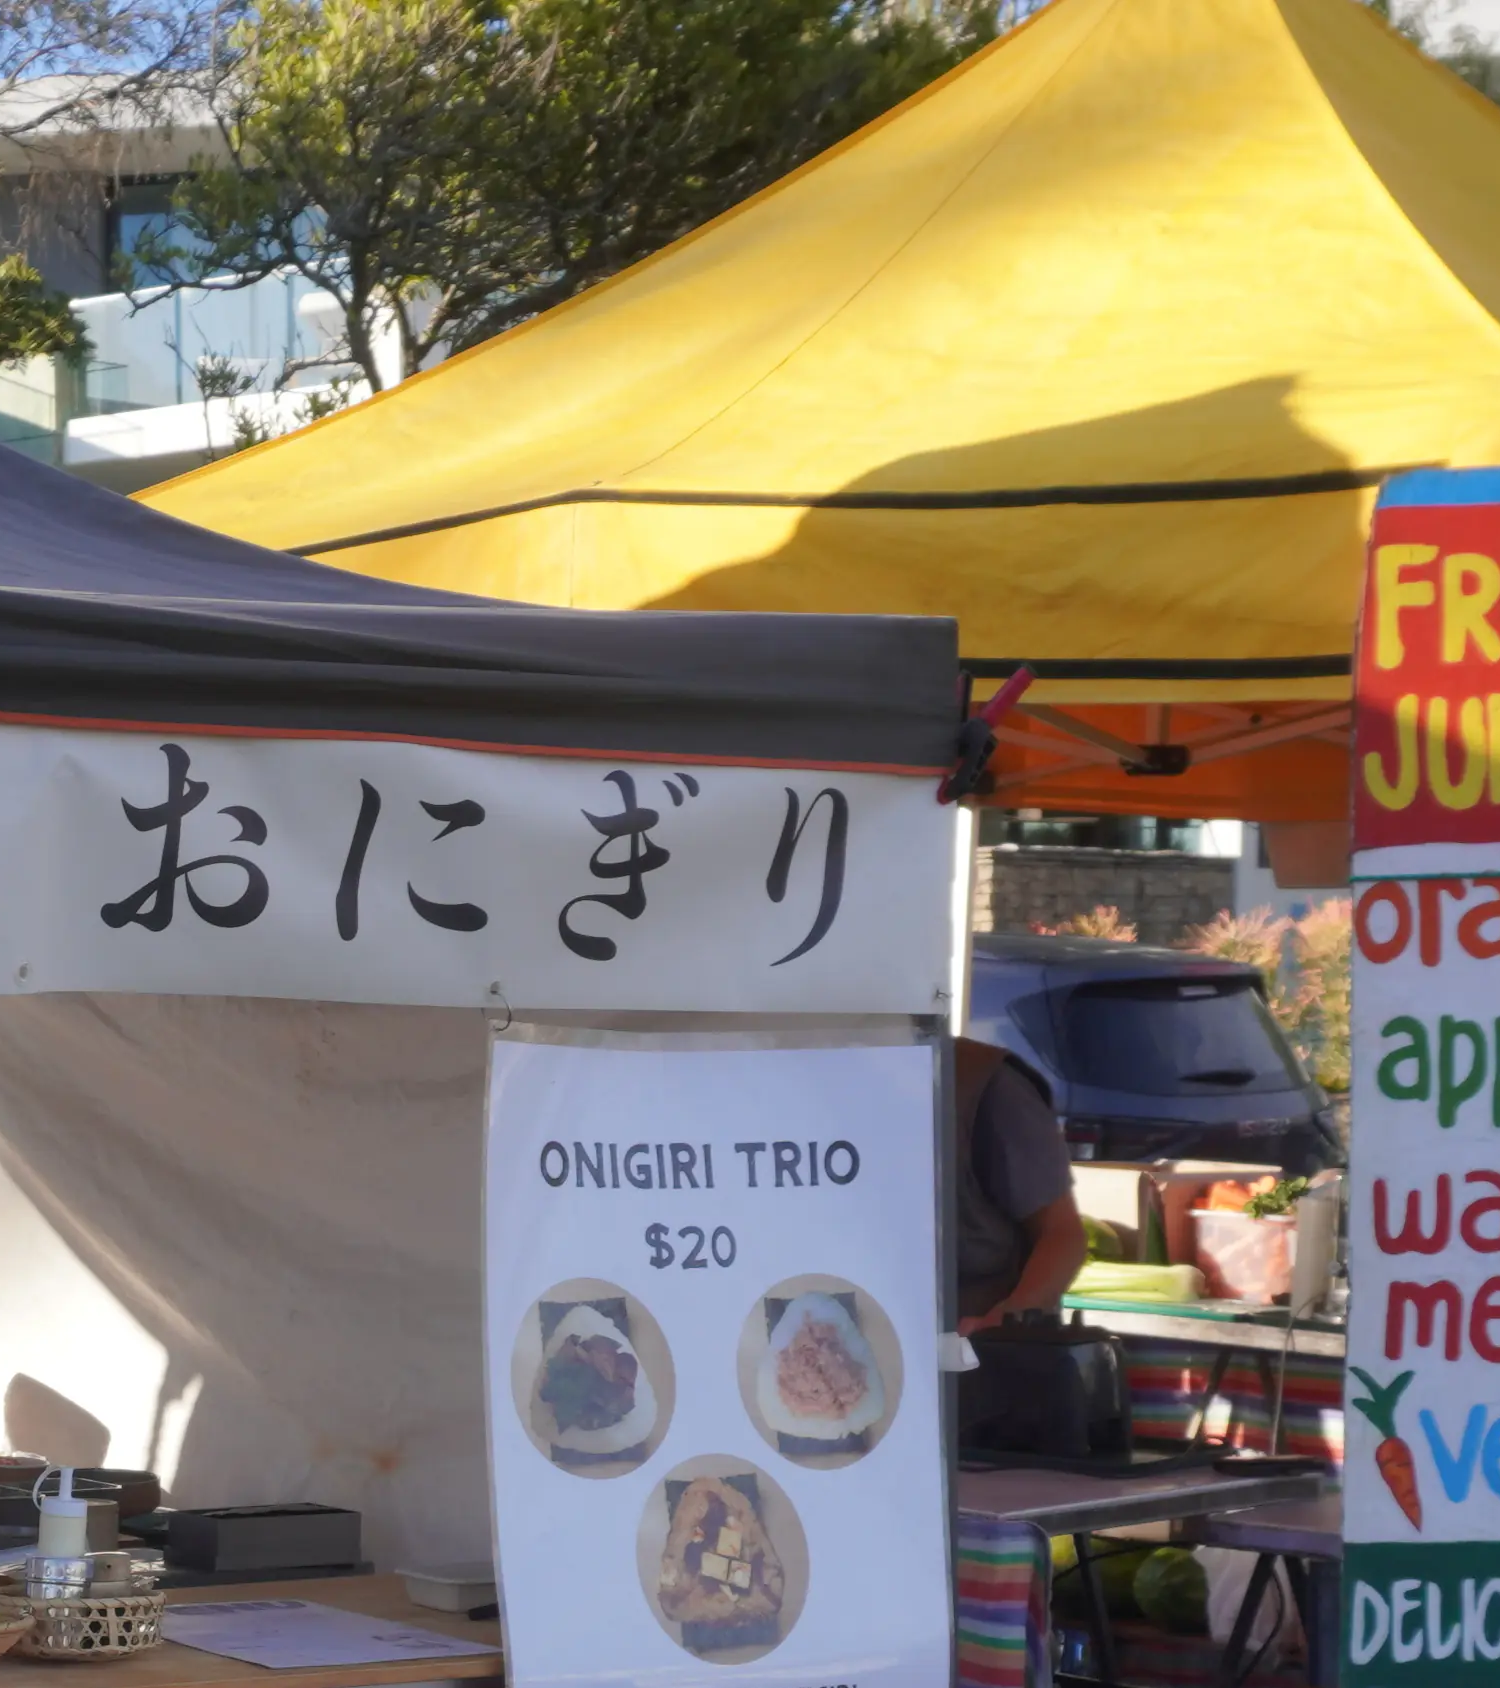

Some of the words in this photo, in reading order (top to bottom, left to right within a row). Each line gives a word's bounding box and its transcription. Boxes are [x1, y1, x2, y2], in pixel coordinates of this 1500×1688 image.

[100, 742, 855, 962] おにぎり
[540, 1141, 716, 1189] ONIGIRI
[735, 1139, 860, 1187] TRIO
[646, 1222, 738, 1269] $20
